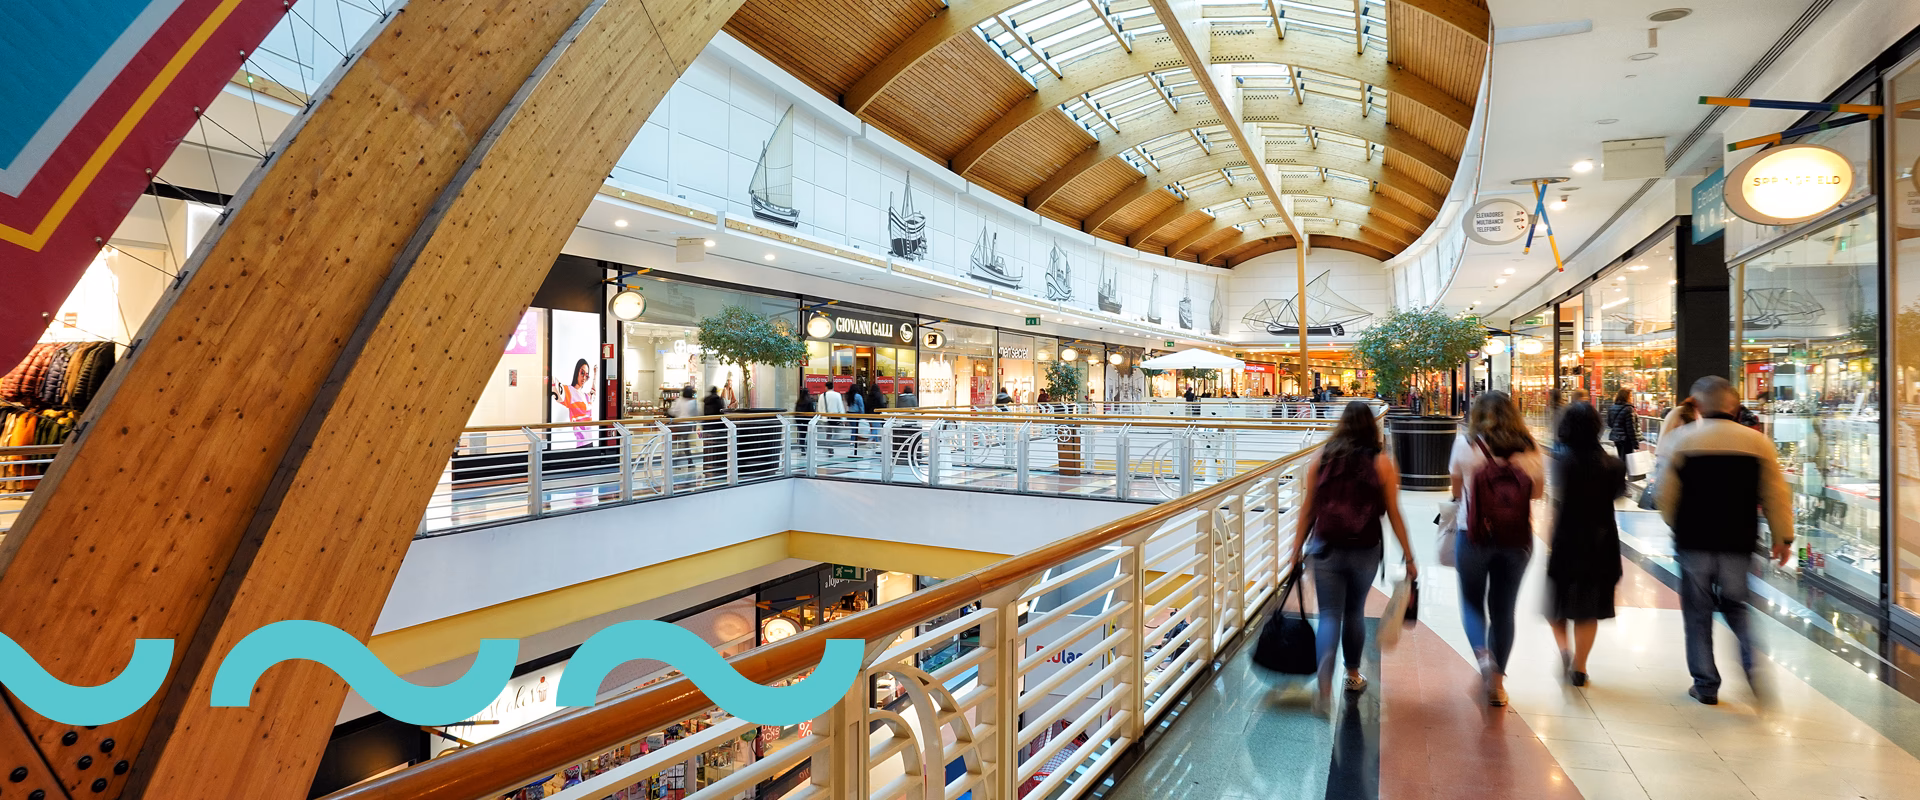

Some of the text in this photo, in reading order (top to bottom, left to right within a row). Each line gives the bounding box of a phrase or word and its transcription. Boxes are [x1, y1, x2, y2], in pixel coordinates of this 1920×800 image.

[1752, 175, 1842, 187] SPRNGFELD
[1476, 211, 1504, 219] ELEVADORES
[1476, 218, 1504, 226] MULTIBANCO
[1476, 225, 1501, 233] TELEFONES
[835, 316, 893, 338] GIOVANNI GALLI
